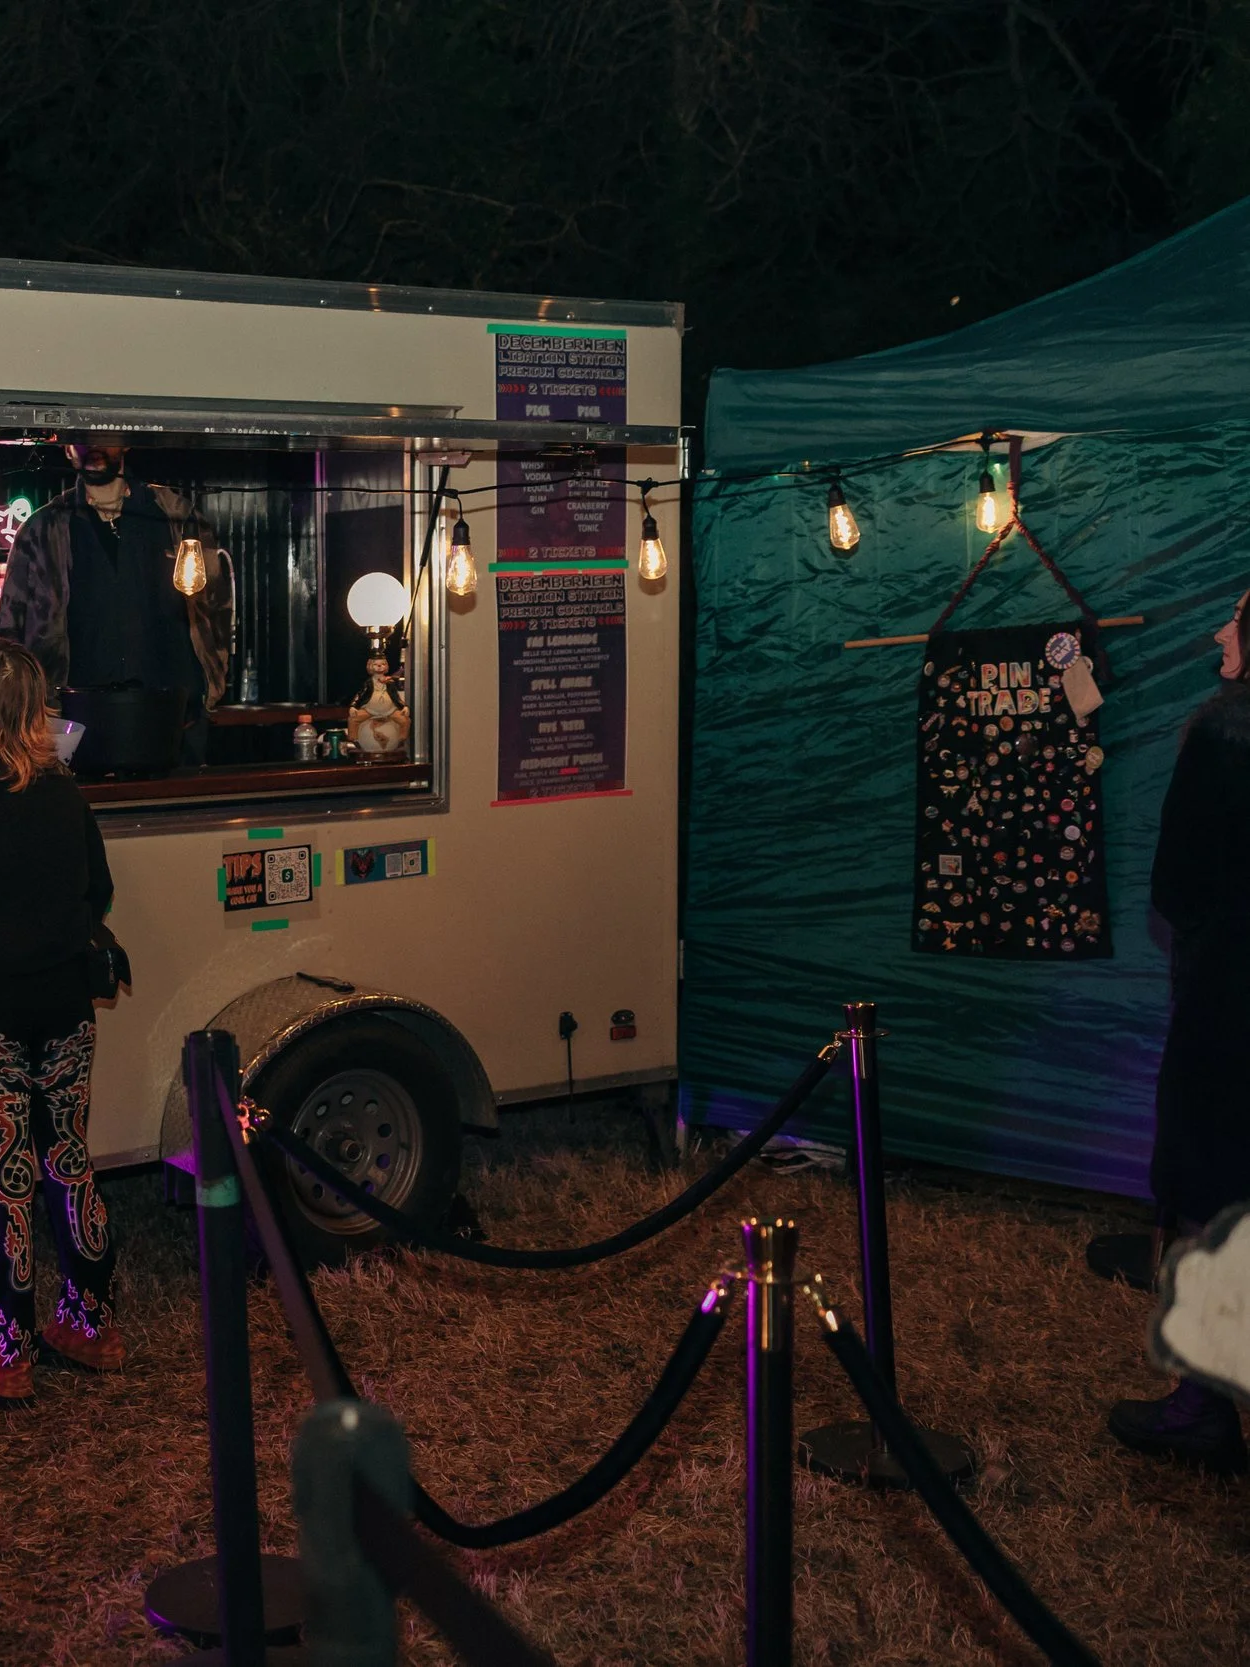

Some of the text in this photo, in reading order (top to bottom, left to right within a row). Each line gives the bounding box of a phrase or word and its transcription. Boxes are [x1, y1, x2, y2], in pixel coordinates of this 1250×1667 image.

[498, 335, 624, 353] DECEMBERWEEN
[499, 352, 624, 366] LIBATION STATION
[499, 366, 624, 380] PREMIUM COCKTAILS
[528, 384, 596, 396] 2 TICKETS
[528, 546, 596, 558] 2 TICKETS
[499, 575, 623, 591] DECEMBERWEEN
[568, 589, 623, 602] STATION
[501, 603, 623, 618] PREMIUM COCKTAILS
[528, 618, 596, 630] 2 TICKETS
[981, 662, 1032, 689] PIN
[967, 688, 1050, 716] TRADE
[224, 852, 262, 882] TIPS
